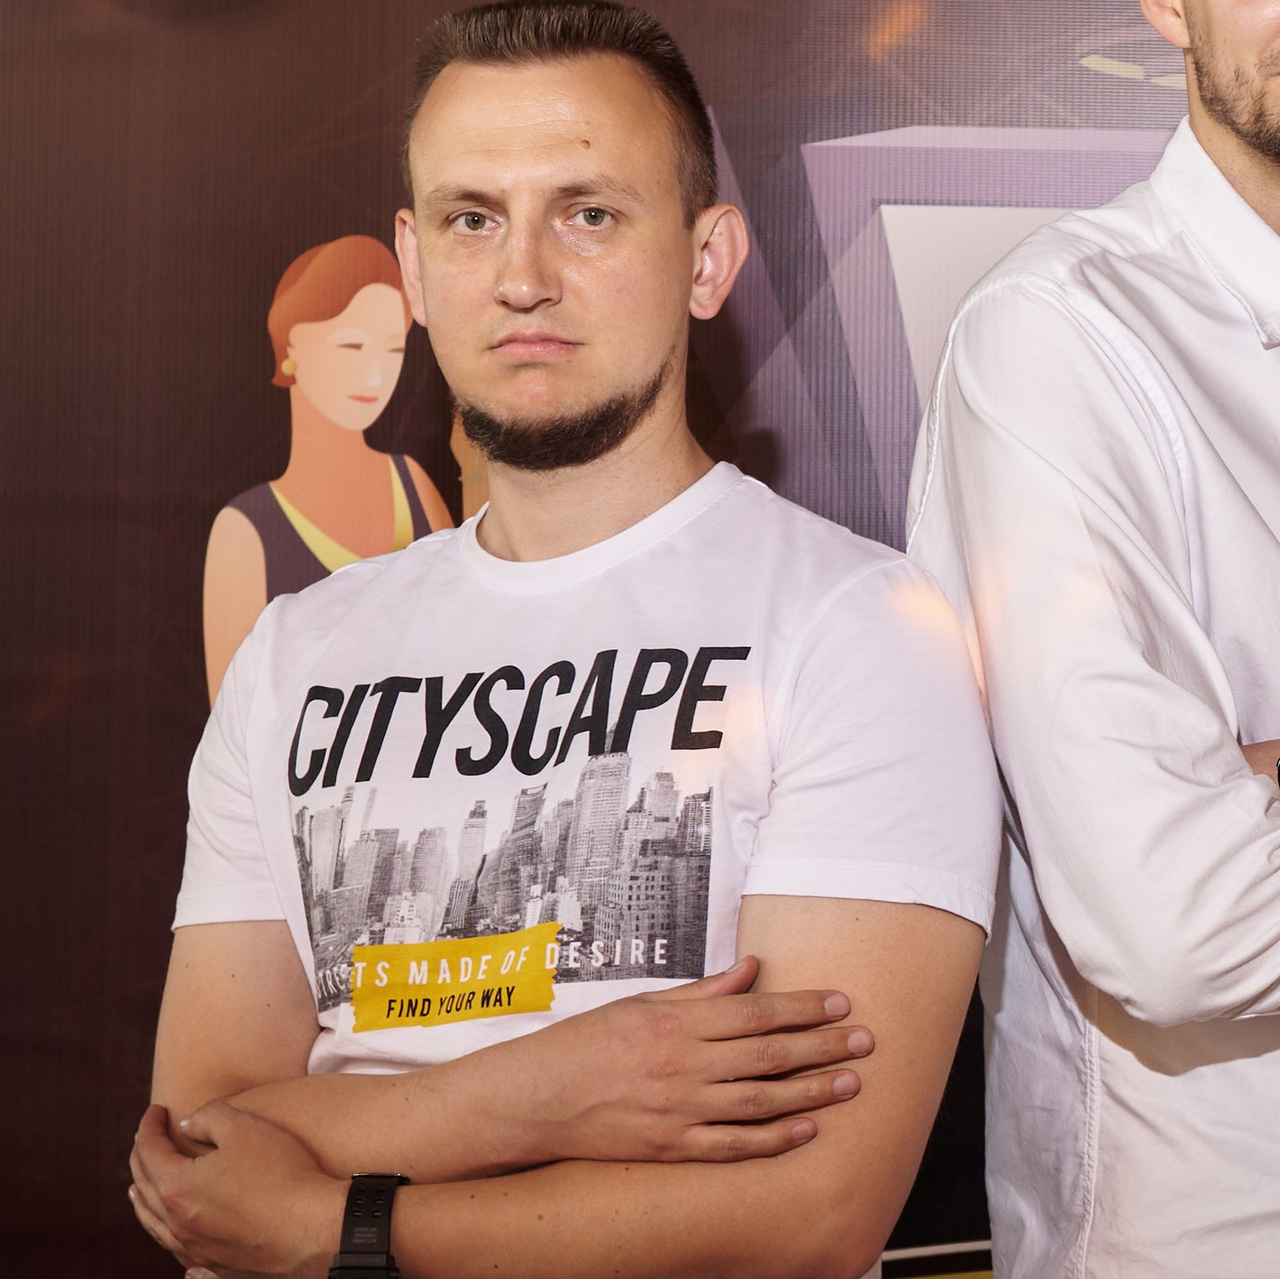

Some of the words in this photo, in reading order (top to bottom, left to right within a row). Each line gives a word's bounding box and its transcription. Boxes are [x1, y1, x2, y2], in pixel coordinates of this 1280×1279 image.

[288, 646, 752, 797] CITYSCAPE
[408, 954, 492, 985] MADE
[500, 945, 530, 975] OF
[545, 938, 668, 970] DESIRE
[386, 998, 431, 1019] FIND
[437, 990, 476, 1017] YOUR
[480, 985, 516, 1009] WAY
